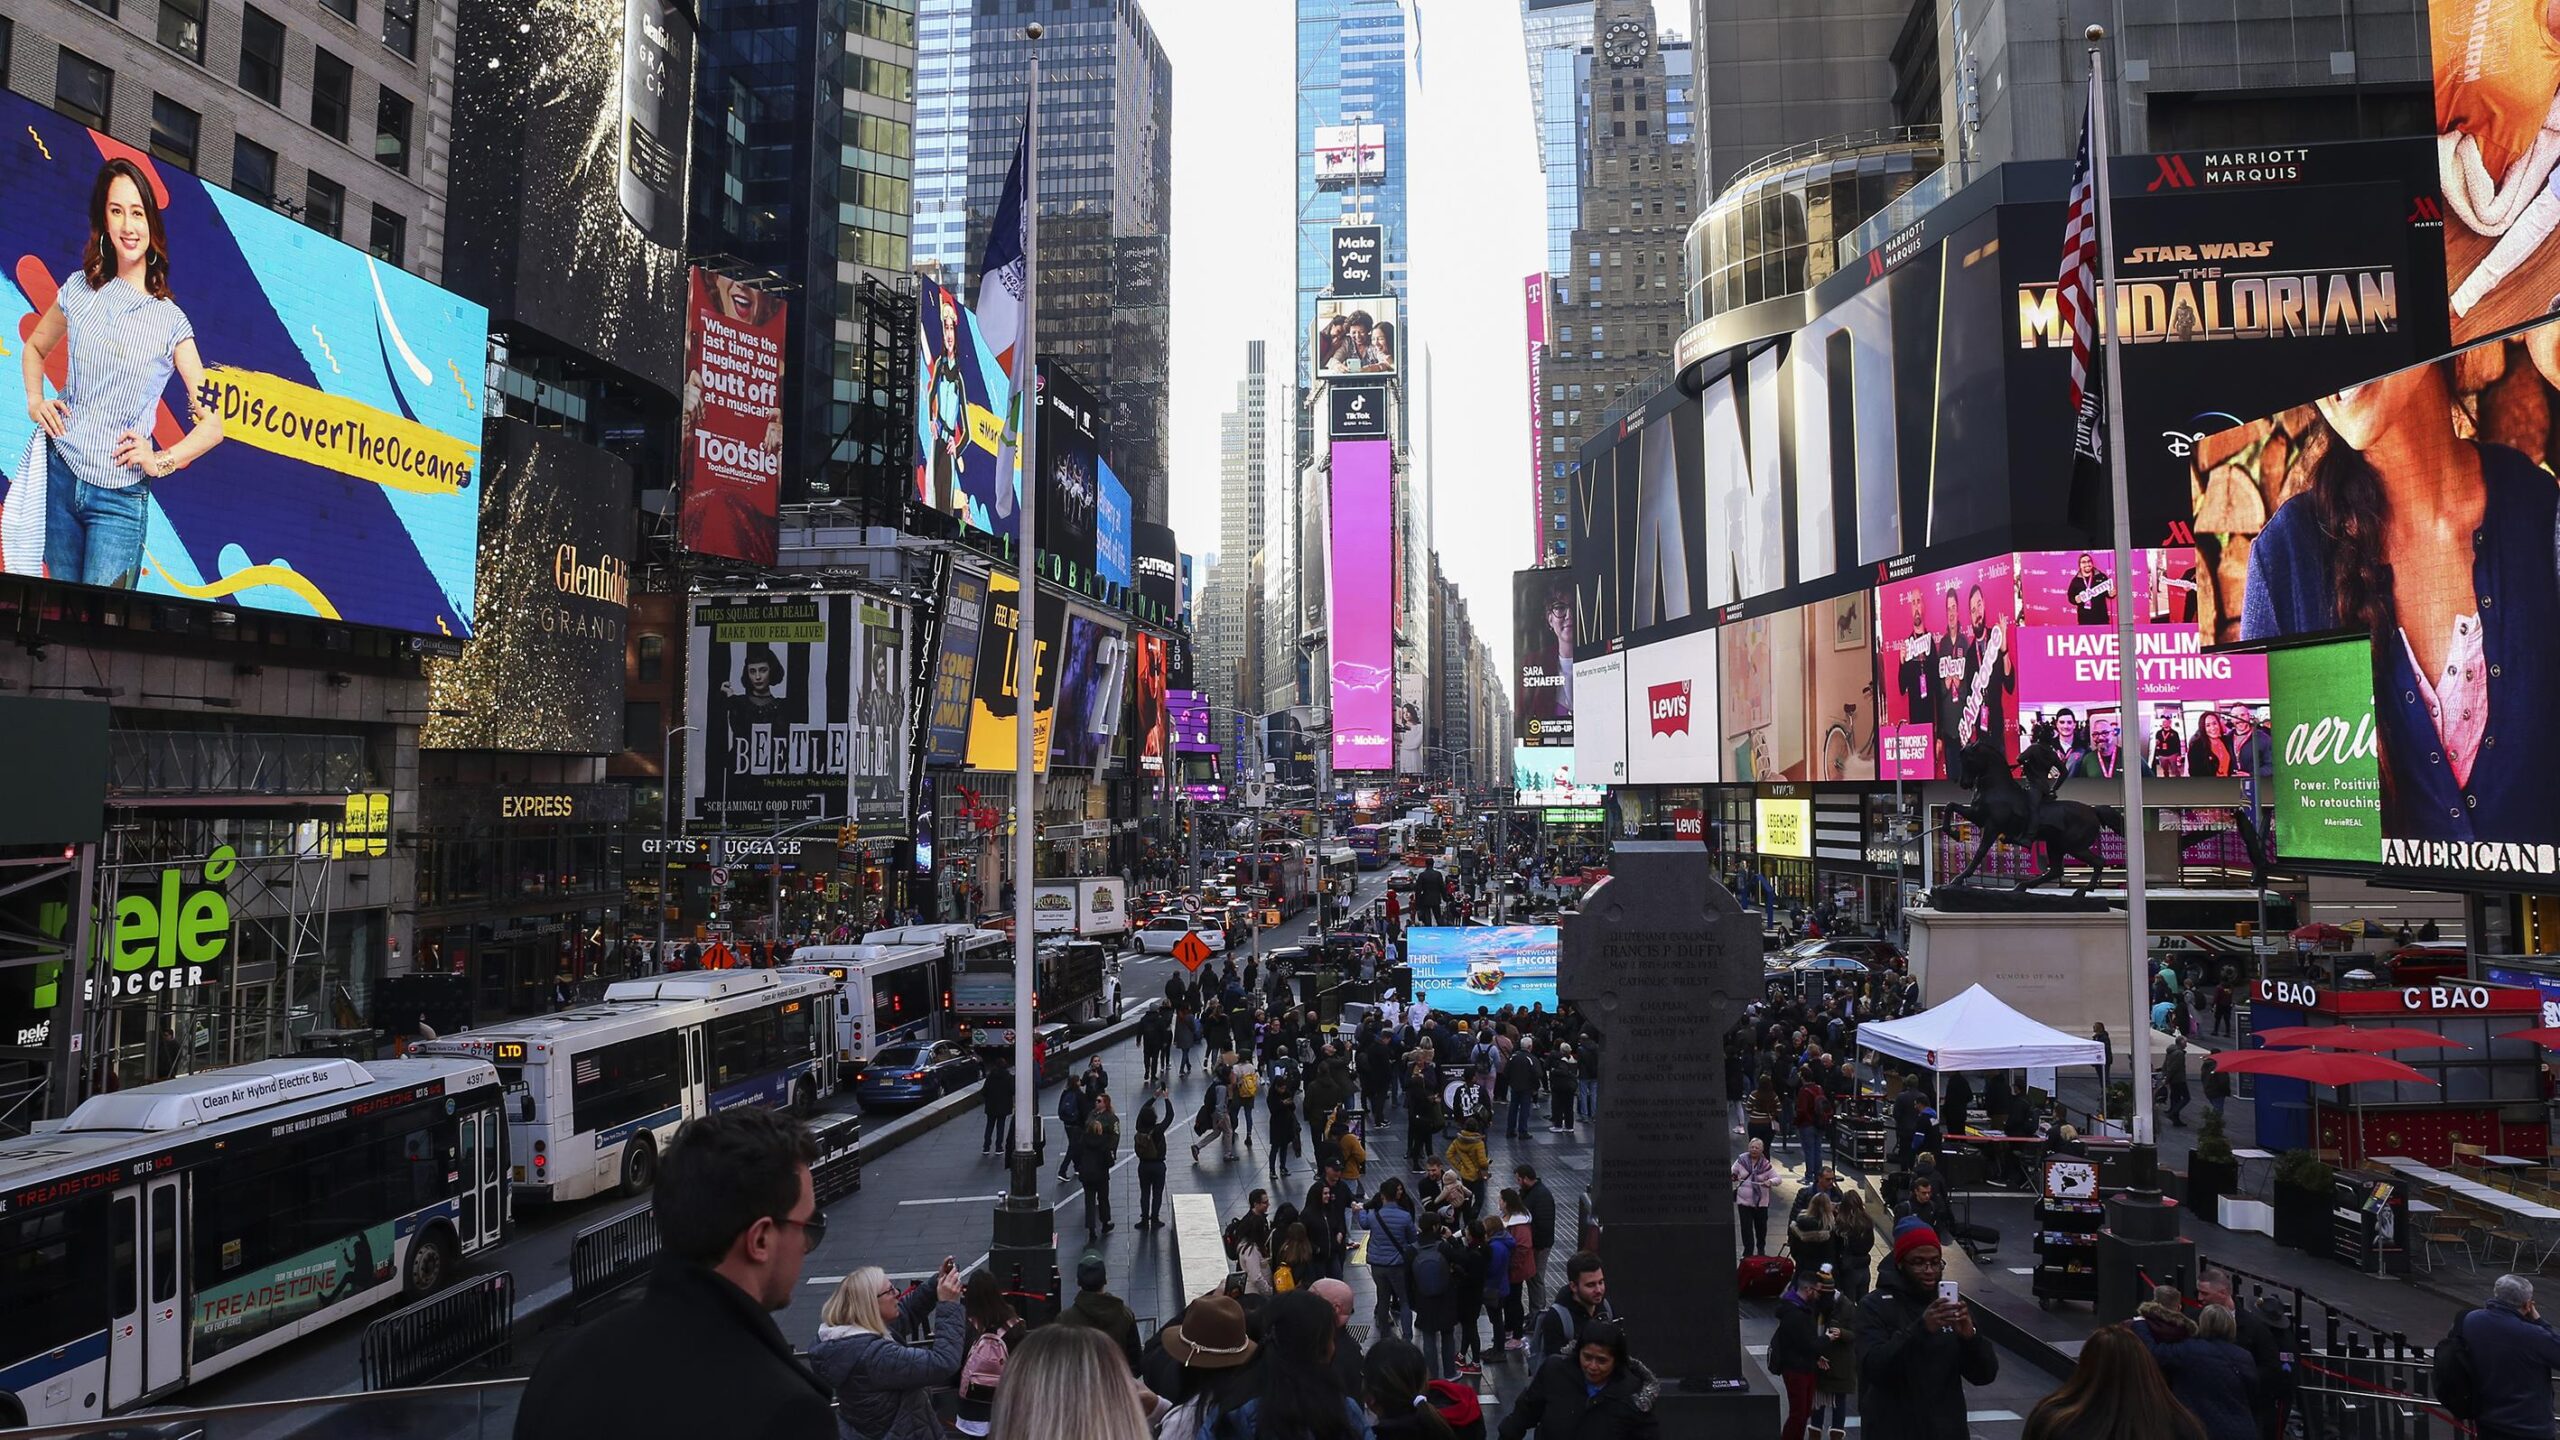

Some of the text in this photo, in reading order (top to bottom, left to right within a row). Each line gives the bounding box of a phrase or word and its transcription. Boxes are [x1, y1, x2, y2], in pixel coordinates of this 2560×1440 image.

[2205, 149, 2309, 167] MARRIOTT
[2206, 165, 2297, 183] MARQUIS
[1338, 236, 1375, 250] Make
[1886, 220, 1926, 252] MARRIOTT
[1341, 251, 1372, 267] your
[1886, 237, 1921, 268] MARQUIS
[2124, 241, 2274, 263] STAR WARS
[1343, 266, 1371, 280] day.
[2179, 267, 2221, 279] THE
[739, 330, 759, 346] was
[761, 334, 777, 353] the
[1681, 322, 1718, 347] MARRIOTT
[703, 331, 777, 369] last time you
[1682, 338, 1714, 362] MARQUIS
[702, 348, 777, 383] laughed your
[701, 366, 777, 406] butt off
[704, 391, 725, 406] at a
[1346, 412, 1371, 420] TikTok
[1627, 405, 1647, 424] MARRIOTT
[1627, 417, 1645, 434] MARQUIS
[196, 381, 472, 489] #DiscoverTheOceans
[695, 428, 778, 475] Tootsie
[707, 461, 767, 483] TootsieMusical.com
[1889, 554, 1916, 568] MARRIOTT
[828, 566, 860, 577] LAMAR
[1889, 566, 1914, 578] MARQUIS
[2080, 579, 2113, 603] #Army
[698, 604, 816, 621] TIMES SQUARE CAN REALLY
[994, 604, 1007, 628] FEEL
[541, 607, 616, 642] GRAND
[720, 624, 823, 639] MAKE YOU FEEL ALIVE!
[2047, 635, 2053, 657] I
[2057, 634, 2119, 657] HAVE
[941, 651, 974, 680] COME
[1002, 632, 1048, 702] LE
[1523, 666, 1544, 676] SARA
[1939, 656, 1966, 680] #Navy
[937, 675, 971, 704] FROM
[1523, 676, 1566, 688] SCHAEFER
[934, 702, 968, 729] AWAY
[1541, 725, 1573, 733] STAND-UP
[734, 724, 848, 776] BEETLE
[2294, 779, 2330, 791] Power.
[502, 795, 573, 818] EXPRESS
[766, 801, 789, 812] GOOD
[2301, 796, 2381, 811] No retouching
[1767, 814, 1799, 831] LEGENDARY
[2324, 818, 2363, 827] #AerieREAL
[1769, 829, 1797, 846] HOLIDAYS
[724, 839, 802, 855] UGGAGE
[2384, 840, 2541, 873] AMERICAN
[1603, 944, 1660, 958] FRANCIS
[1678, 944, 1725, 957] DUFFY
[2159, 936, 2187, 949] Bus
[1516, 949, 1557, 957] NORWEGIAN
[1516, 956, 1557, 965] ENCORE
[84, 966, 203, 1002] SOCCER
[1619, 976, 1711, 986] CATHOLIC PRIEST
[2261, 979, 2316, 1007] C BAO
[2404, 987, 2490, 1009] C BAO
[17, 1020, 50, 1045] pelé
[471, 1046, 493, 1057] 6712
[499, 1044, 523, 1058] LTD
[467, 1073, 484, 1087] 4397
[202, 1071, 328, 1109] Clean Air Hybrid Electric Bus
[272, 1125, 285, 1138] FROM
[286, 1121, 295, 1134] THE
[295, 1118, 310, 1132] WORLD
[311, 1116, 316, 1128] OF
[317, 1113, 331, 1127] JASON
[331, 1110, 348, 1124] BOURNE
[133, 1161, 145, 1176] OCT
[145, 1159, 153, 1172] 15
[275, 1272, 285, 1283] FROM
[286, 1270, 294, 1279] THE
[294, 1267, 306, 1278] WORLD
[203, 1269, 336, 1321] TREADSTONE
[203, 1316, 242, 1334] NEW EVENT SERIES
